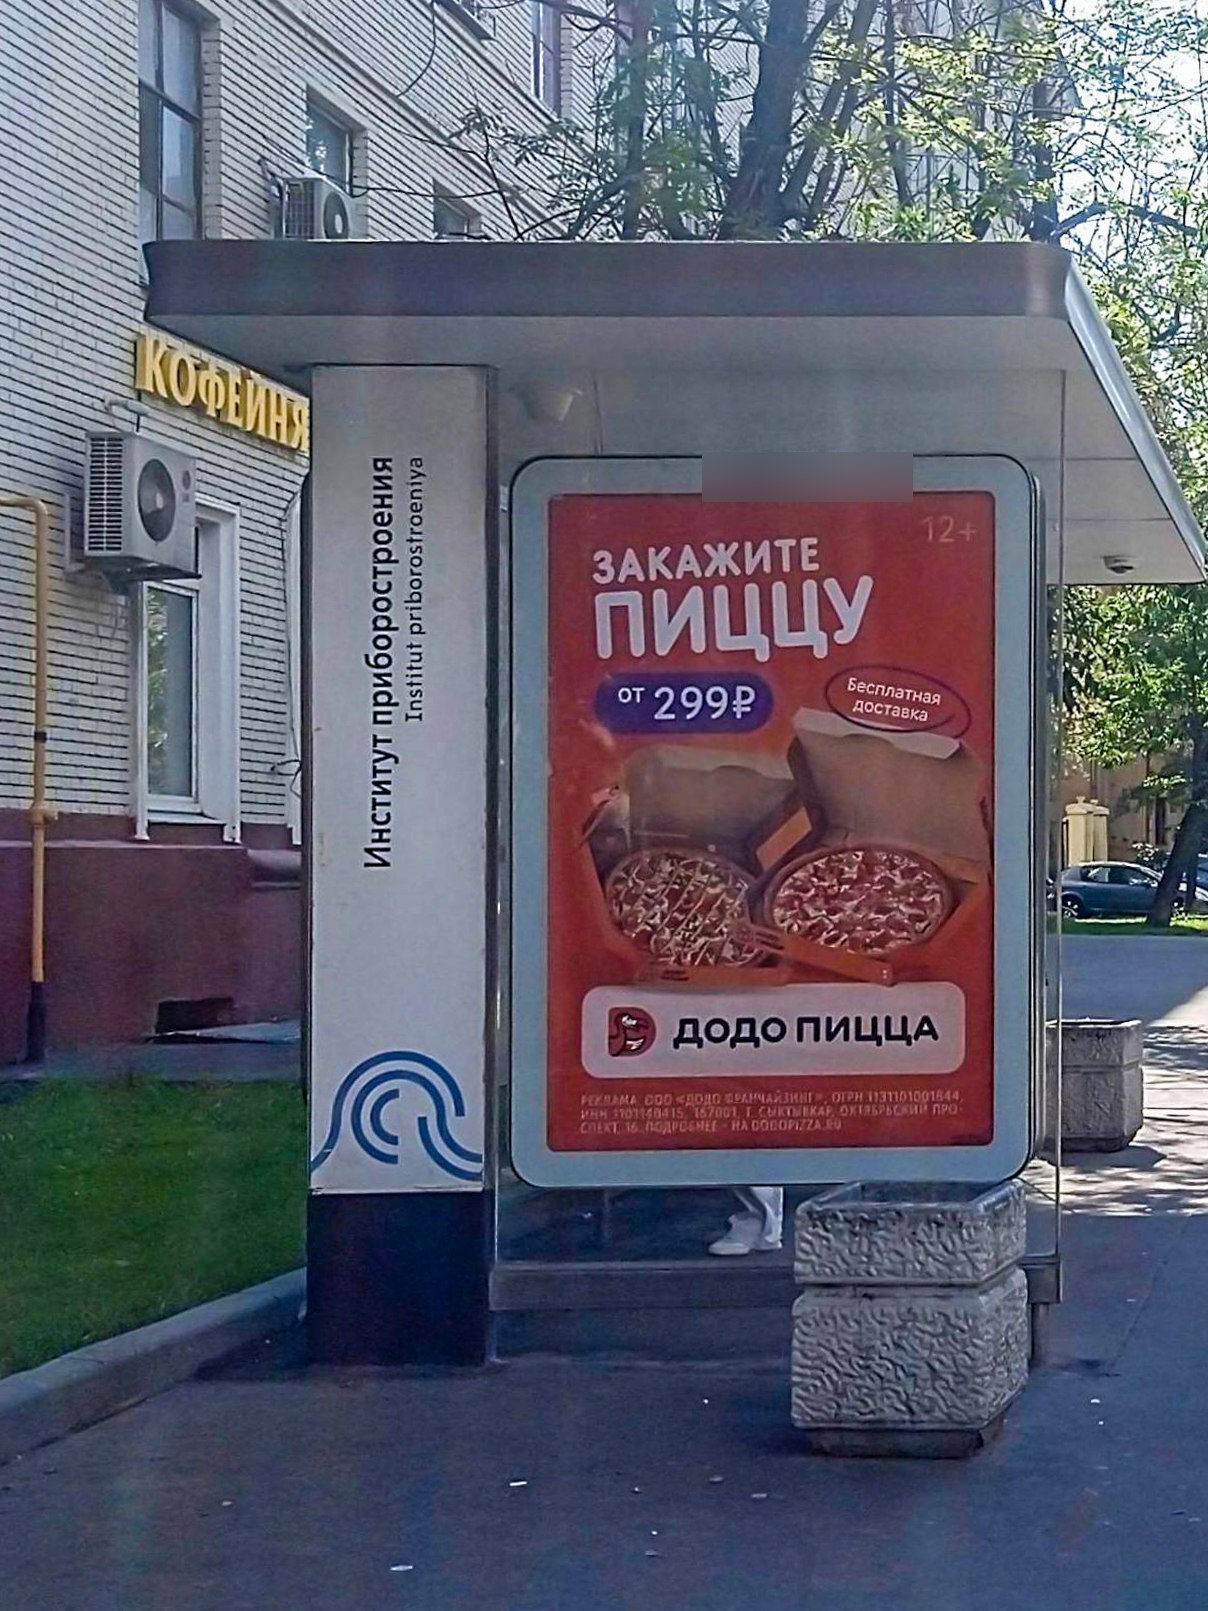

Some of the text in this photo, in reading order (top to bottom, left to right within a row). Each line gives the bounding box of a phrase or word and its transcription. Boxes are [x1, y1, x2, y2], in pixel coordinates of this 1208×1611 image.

[137, 333, 309, 454] КОФЕЙНЯ
[921, 516, 976, 542] 12+
[592, 537, 820, 584] ЗАКАЖИТЕ
[404, 457, 426, 722] Institut priborostroeniya
[595, 575, 874, 663] ПИЦЦУ
[363, 457, 399, 868] Институт приборостроения
[847, 677, 941, 705] Бесплатная
[852, 698, 929, 722] доставка
[673, 1014, 939, 1049] ДОДО ПИЦЦА
[832, 1091, 864, 1103] ОГРН
